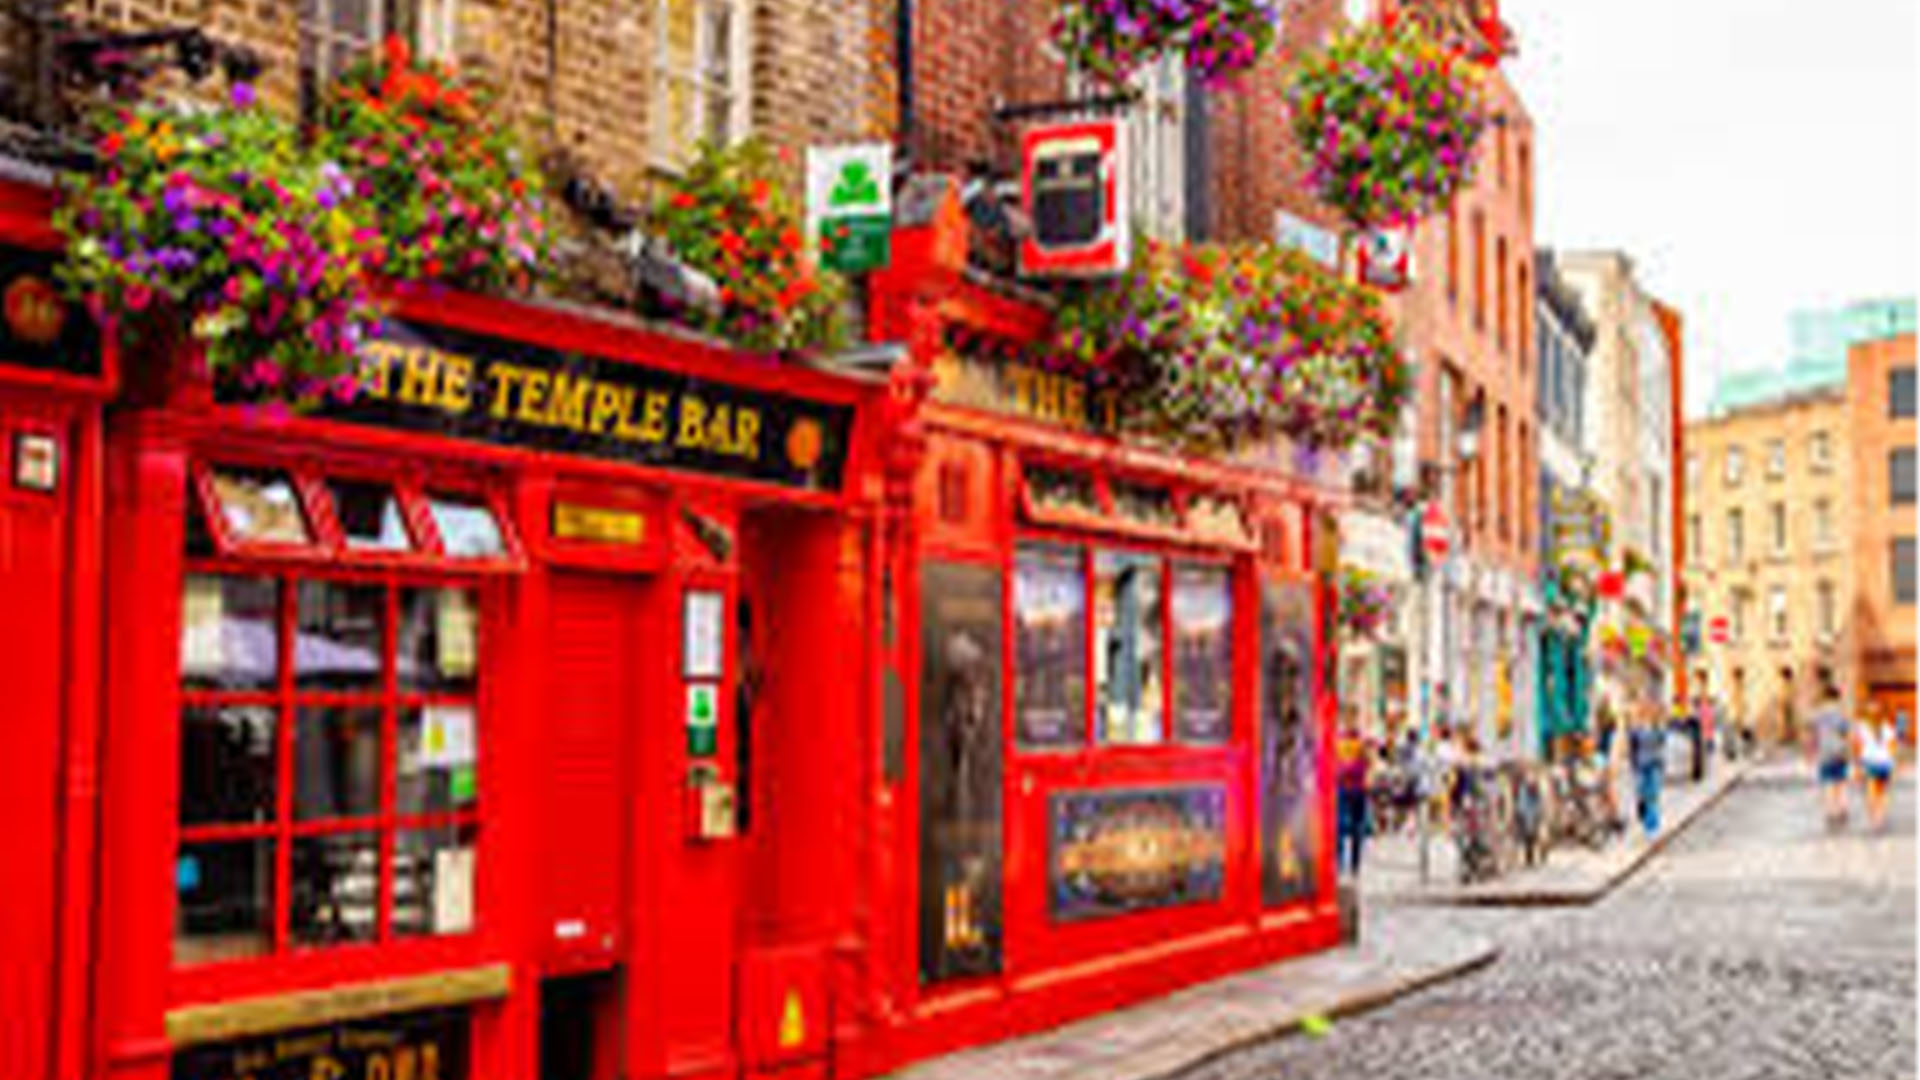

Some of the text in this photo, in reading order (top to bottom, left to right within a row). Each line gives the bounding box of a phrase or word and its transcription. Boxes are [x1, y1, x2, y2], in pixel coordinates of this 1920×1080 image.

[366, 341, 761, 460] THE TEMPLE BAR
[1003, 363, 1088, 430] THE
